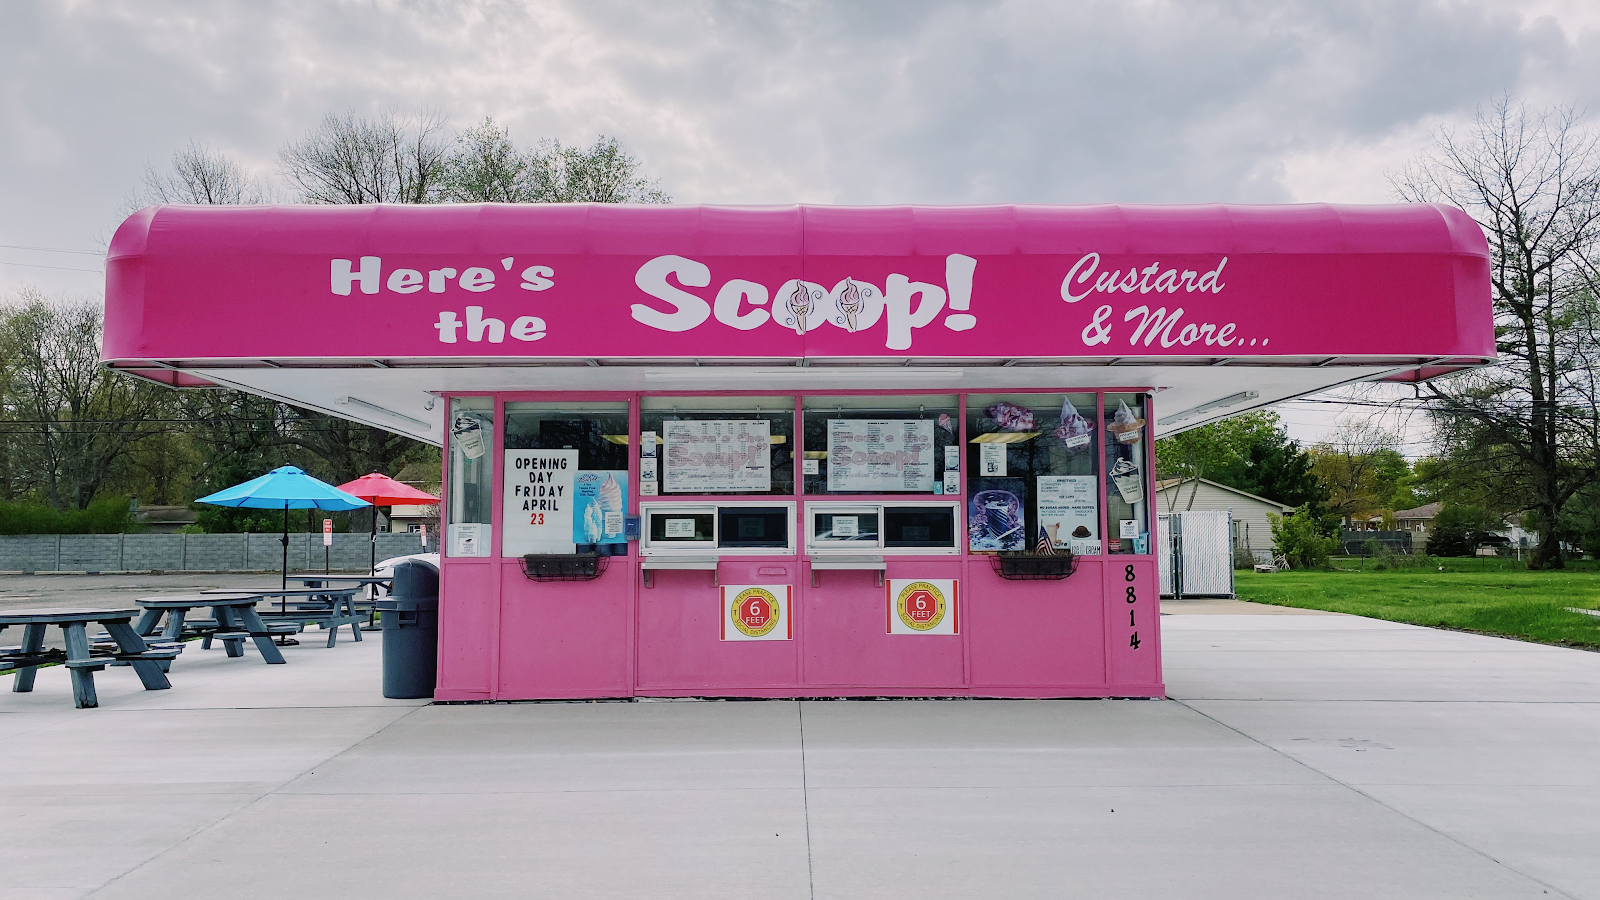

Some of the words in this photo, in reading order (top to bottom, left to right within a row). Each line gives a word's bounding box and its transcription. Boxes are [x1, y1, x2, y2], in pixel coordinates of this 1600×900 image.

[330, 255, 555, 296] Here's
[1060, 252, 1228, 303] Custard
[630, 253, 978, 351] Scoop!
[433, 305, 547, 344] the
[1081, 304, 1113, 347] &
[1124, 304, 1269, 349] More...
[515, 457, 567, 470] OPENING
[529, 471, 553, 484] DAY
[515, 485, 564, 497] FRIDAY
[522, 499, 559, 511] APRIL
[530, 513, 544, 525] 23
[735, 590, 752, 604] PLEASE
[752, 589, 776, 603] PRACTICE
[901, 583, 917, 598] PLEASE
[918, 583, 941, 598] PRACTICE
[750, 601, 761, 616] 6
[916, 595, 927, 610] 6
[1125, 564, 1141, 650] 8814
[745, 616, 765, 624] FEET
[911, 610, 931, 618] FEET
